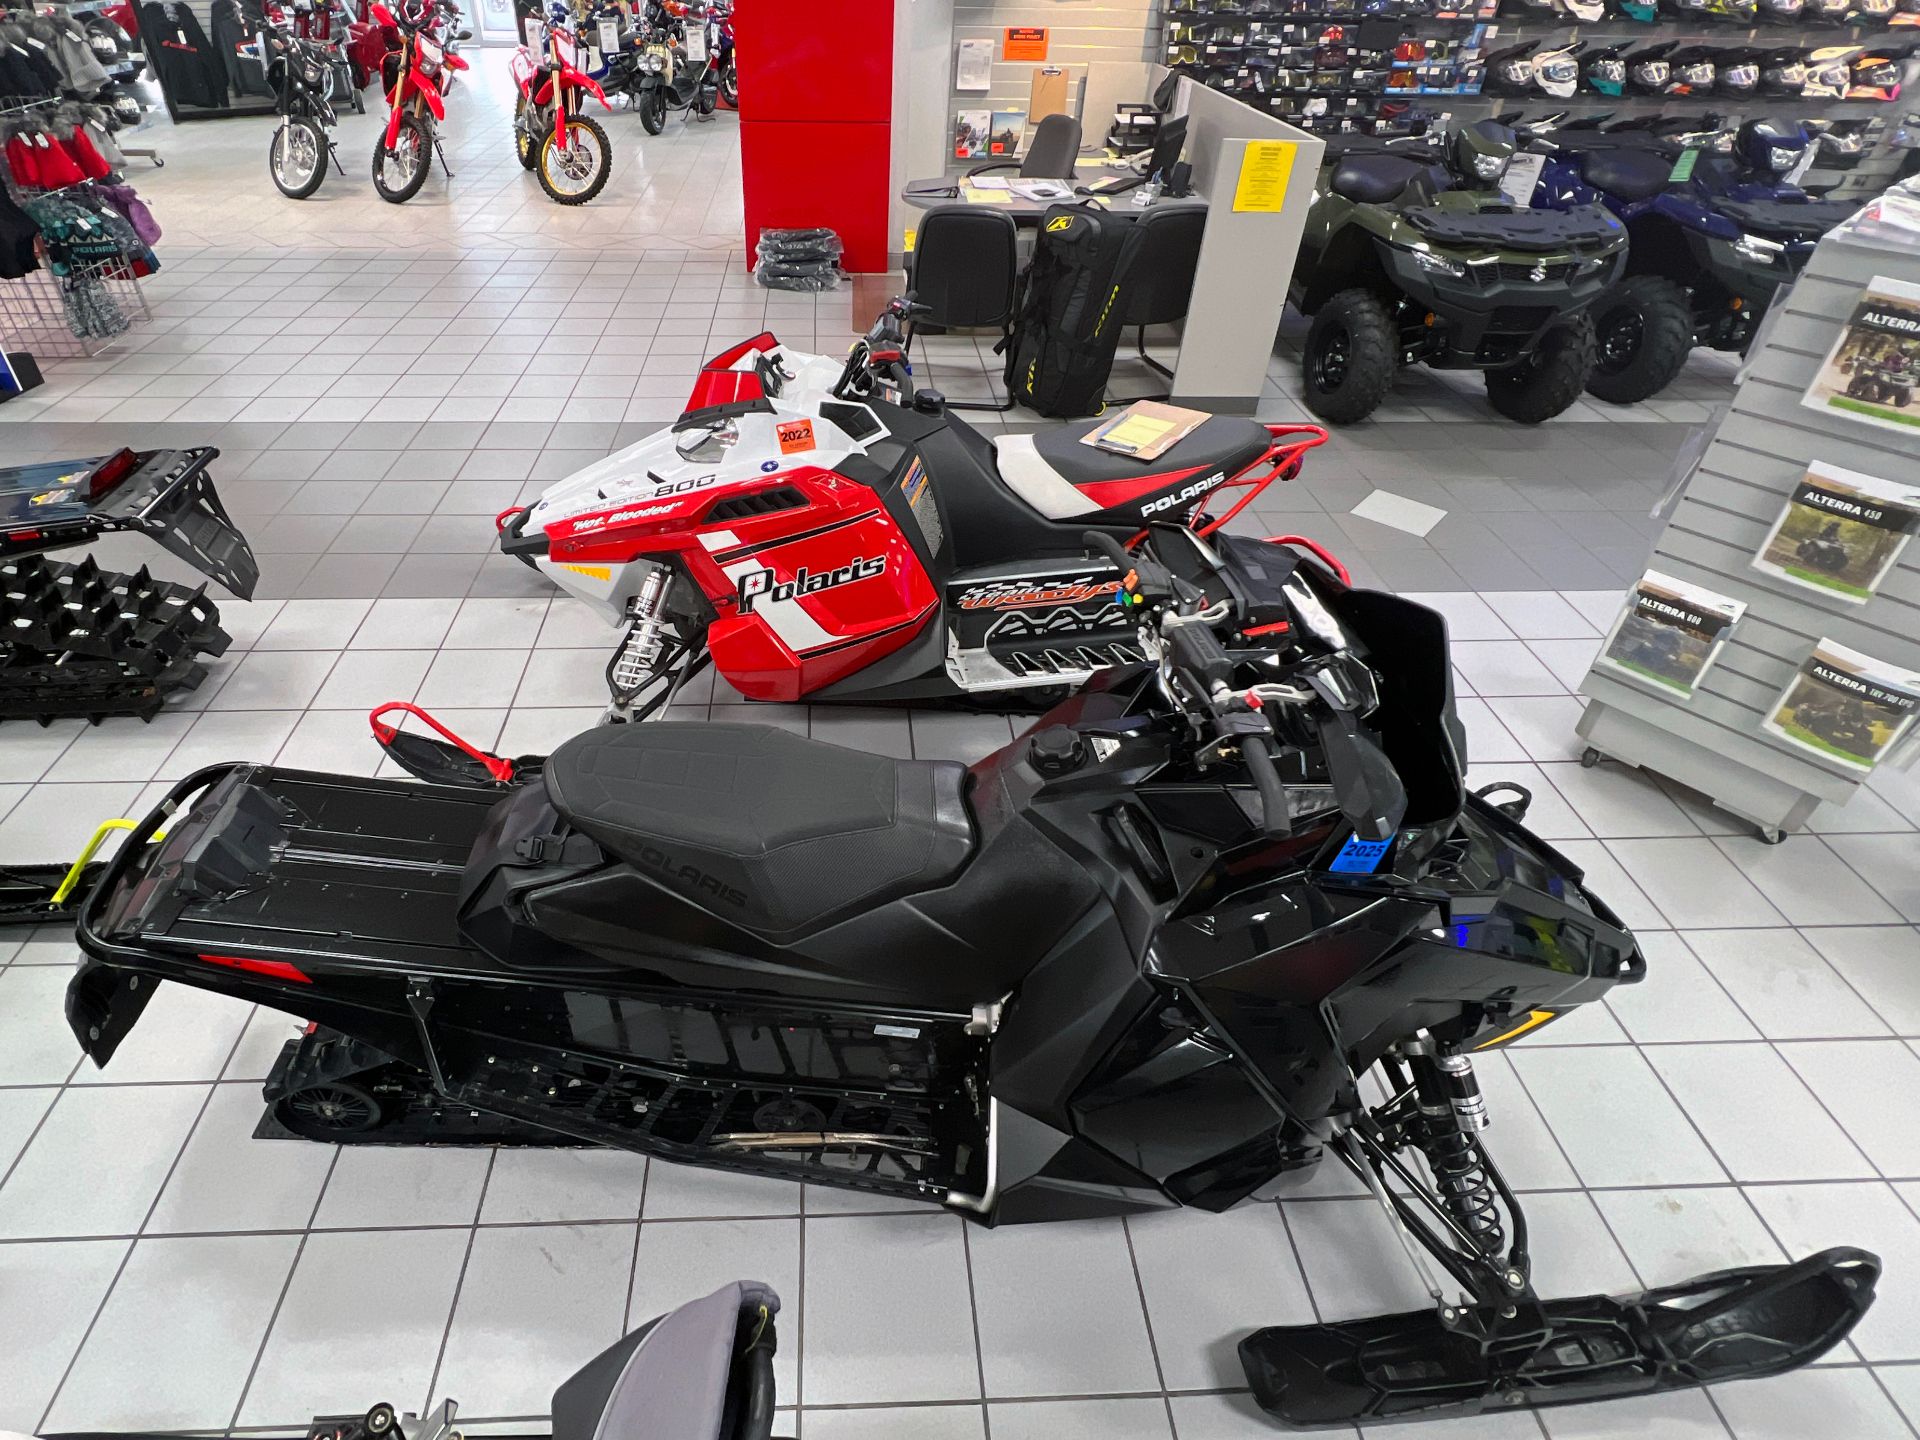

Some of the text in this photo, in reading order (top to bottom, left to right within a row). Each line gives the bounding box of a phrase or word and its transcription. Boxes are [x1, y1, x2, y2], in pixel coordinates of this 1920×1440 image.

[72, 244, 118, 255] POLARIS
[780, 428, 812, 442] 2022
[564, 503, 606, 518] LIMITED
[654, 474, 716, 497] 800
[1141, 471, 1225, 518] POLARIS
[1804, 491, 1882, 520] ALTERRA 450
[736, 556, 886, 614] Polaris
[1640, 597, 1702, 625] ALTERRA 600
[1813, 666, 1867, 693] ALTERRA
[1343, 844, 1386, 857] 2025
[622, 836, 749, 908] POLARIS
